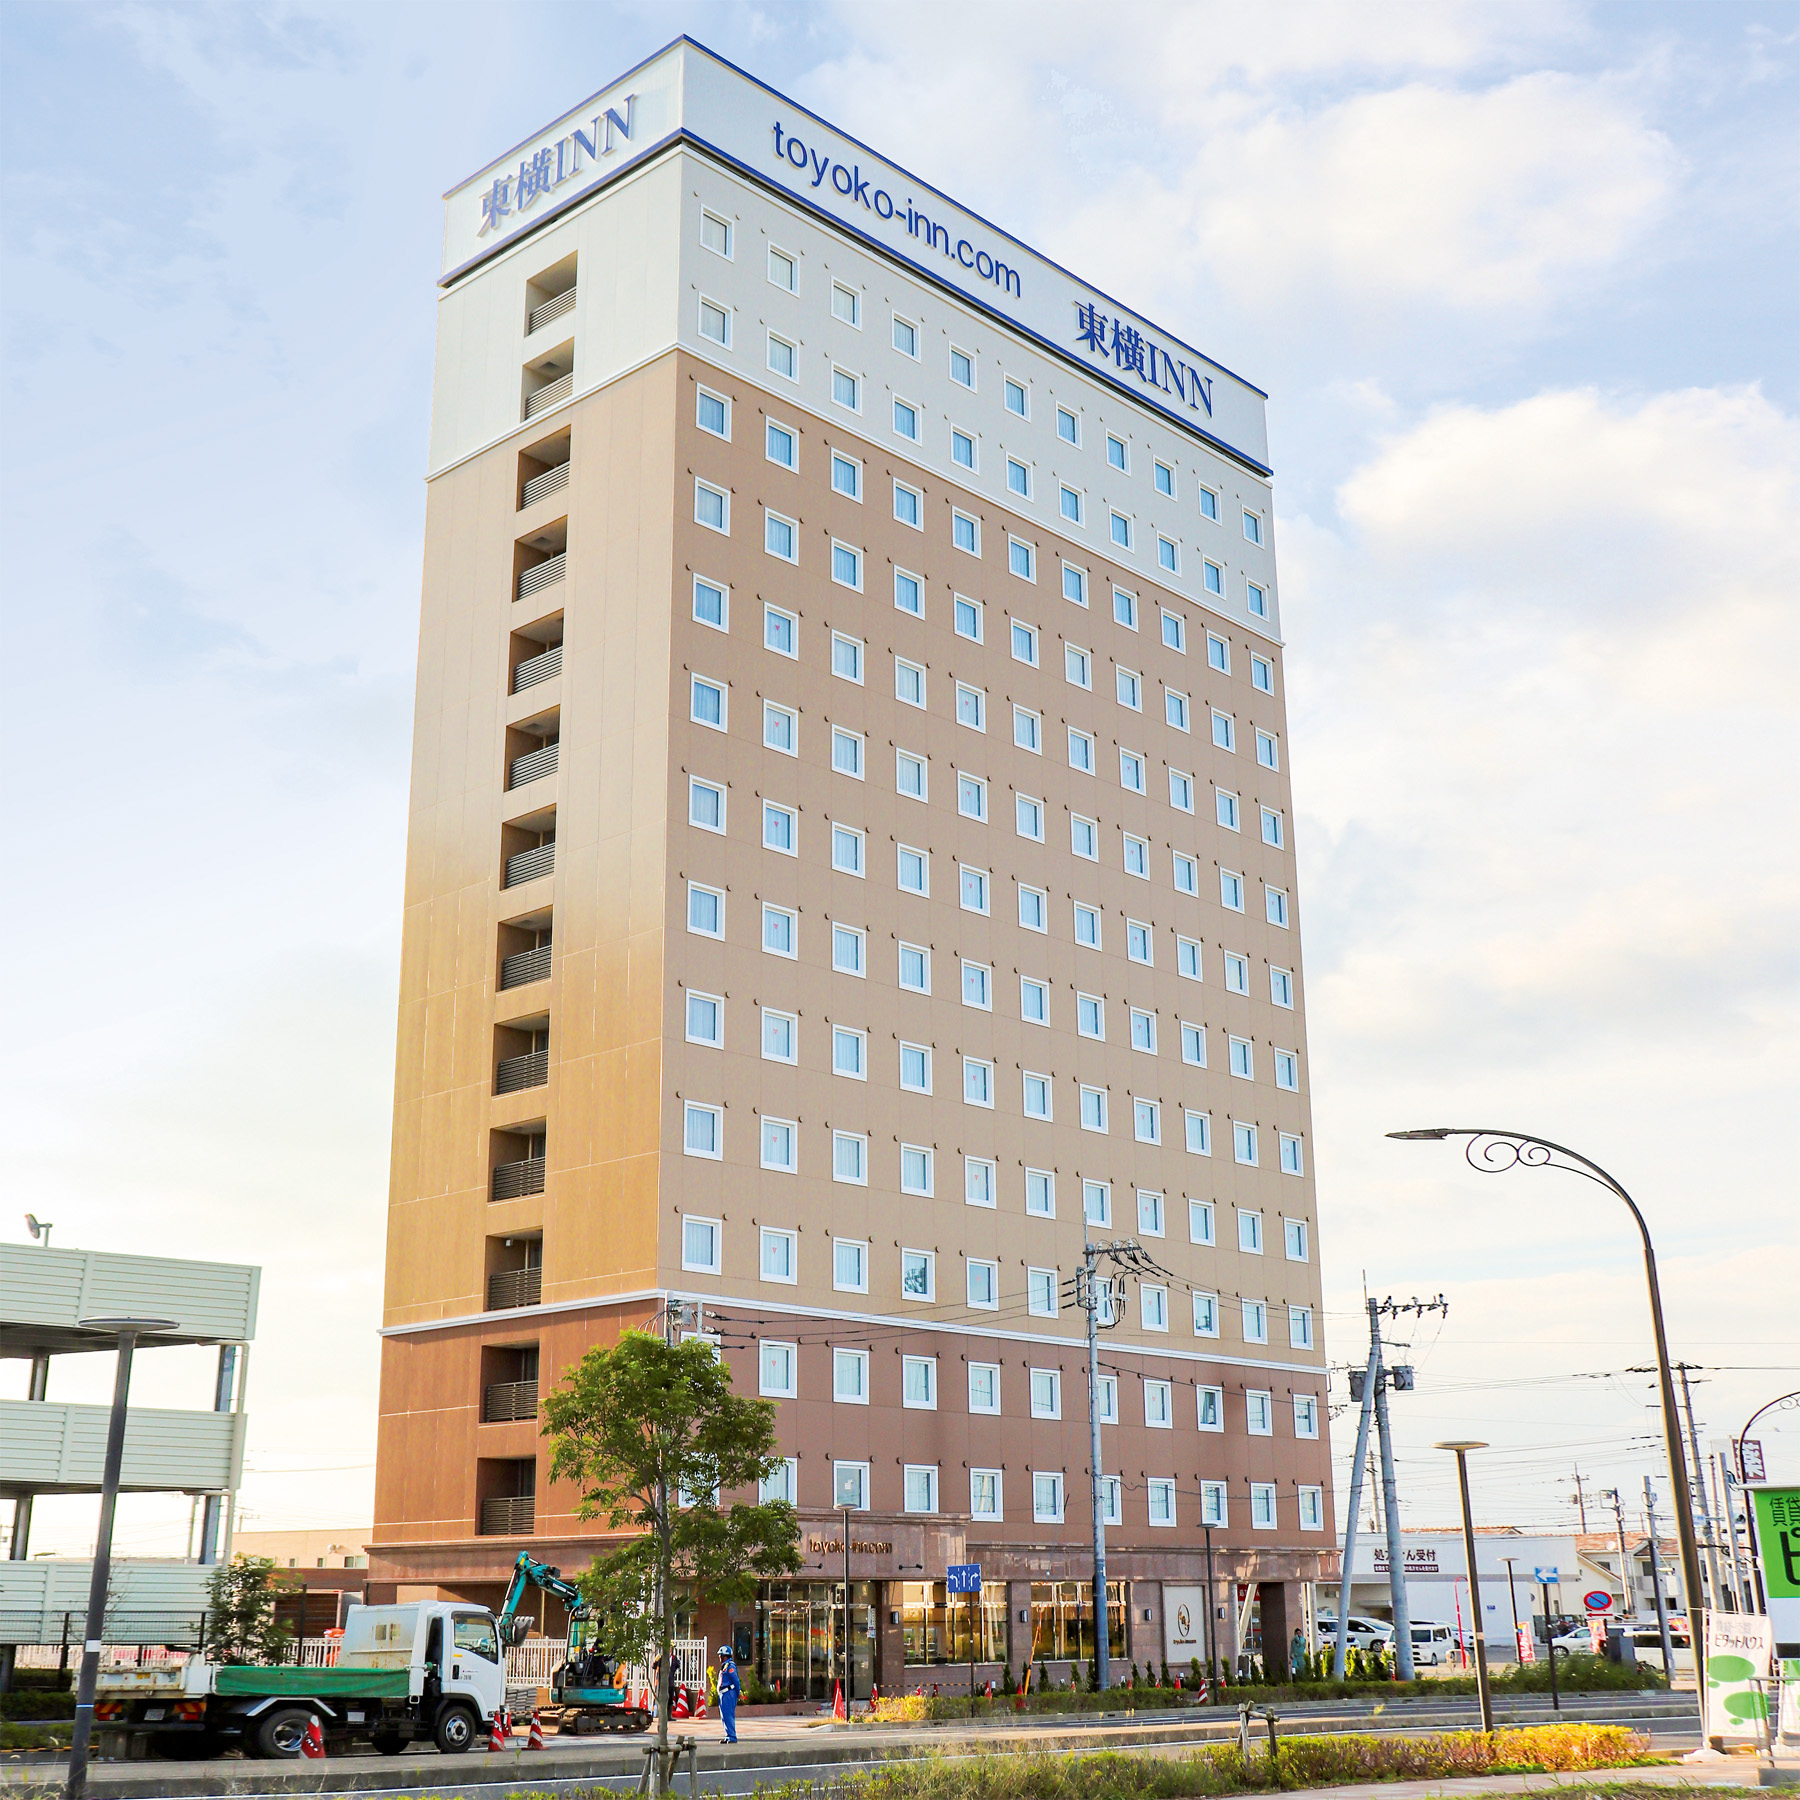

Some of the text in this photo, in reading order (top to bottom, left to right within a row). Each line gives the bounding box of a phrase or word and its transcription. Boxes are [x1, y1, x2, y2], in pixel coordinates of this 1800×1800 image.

[477, 93, 636, 236] 東横INN
[773, 121, 1021, 298] toyoko-inn.com
[1074, 300, 1213, 418] 東横INN
[1714, 1633, 1764, 1649] ピタットハウス
